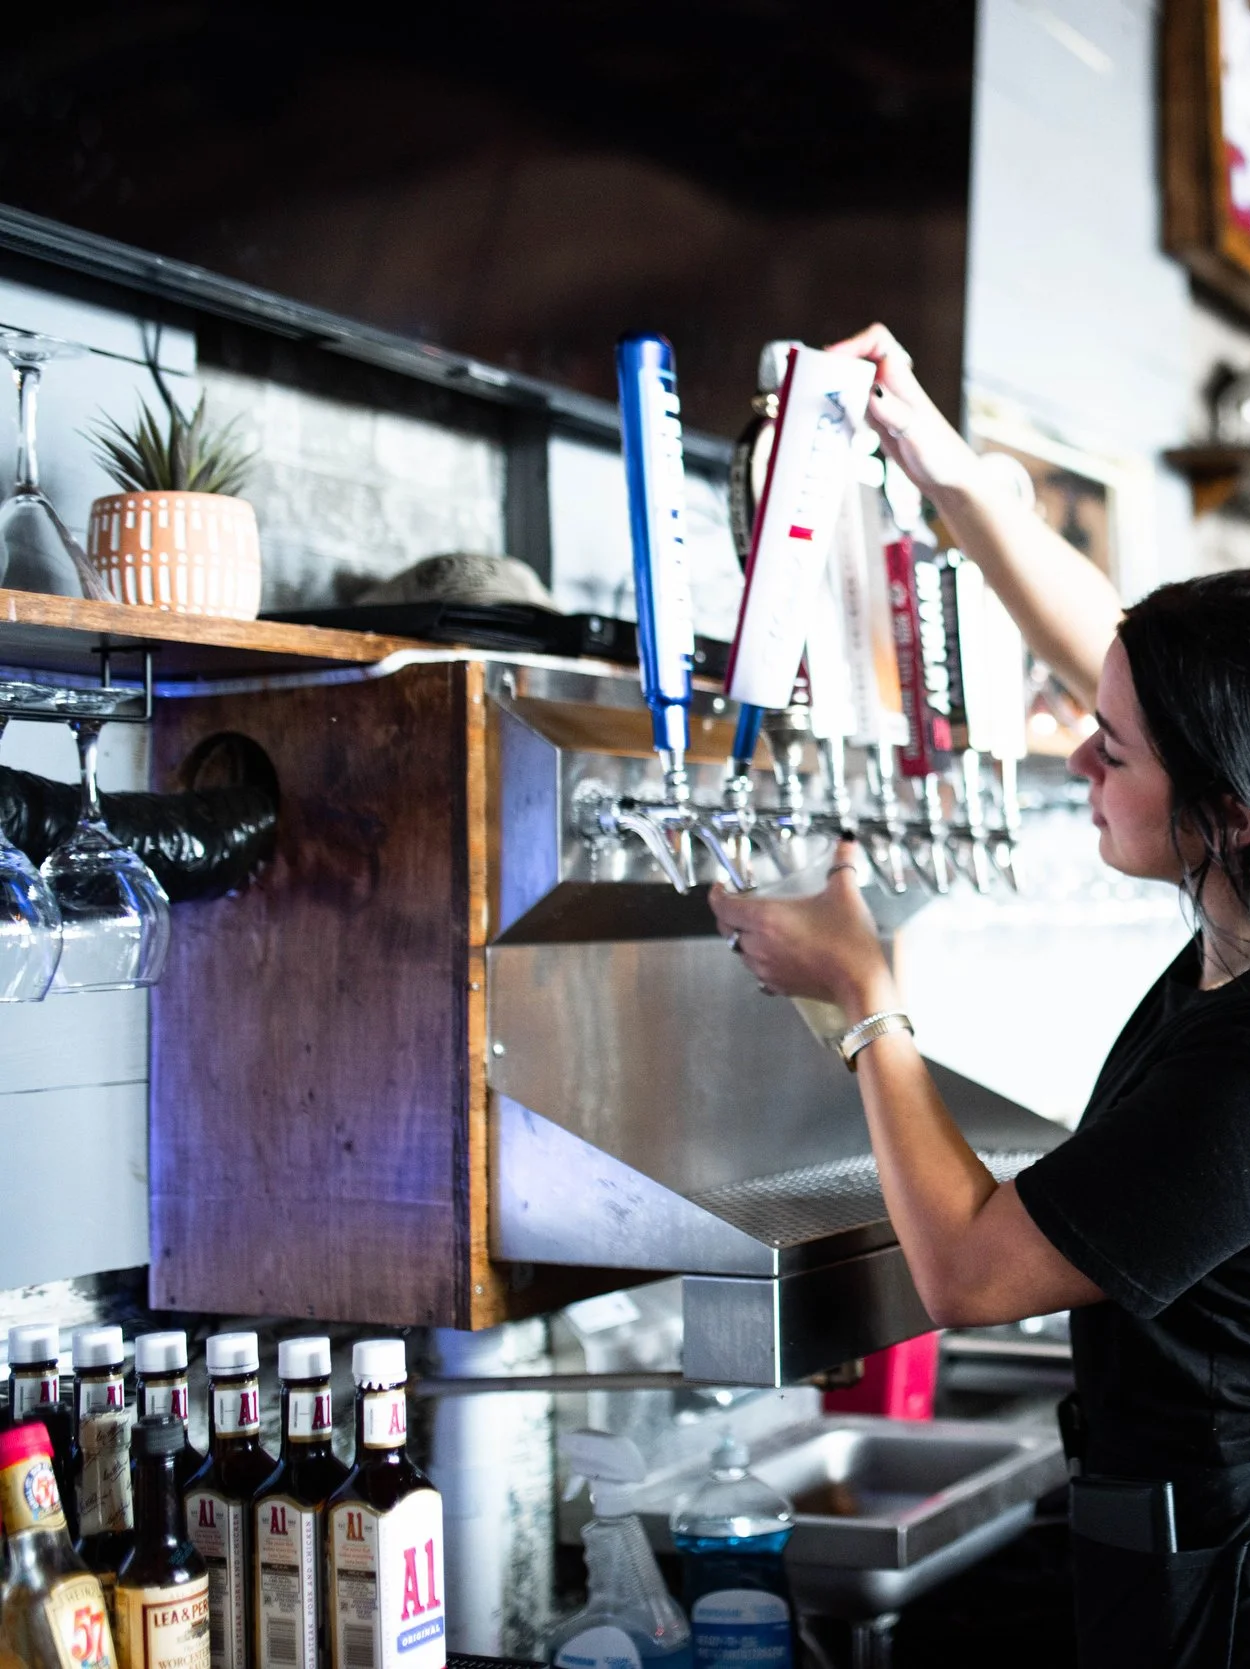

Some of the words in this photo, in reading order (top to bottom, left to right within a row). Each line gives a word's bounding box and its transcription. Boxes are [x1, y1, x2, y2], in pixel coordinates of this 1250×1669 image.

[401, 1538, 440, 1621] A1
[154, 1610, 179, 1628] LEA
[181, 1607, 190, 1621] &
[402, 1624, 440, 1648] ORIGINAL
